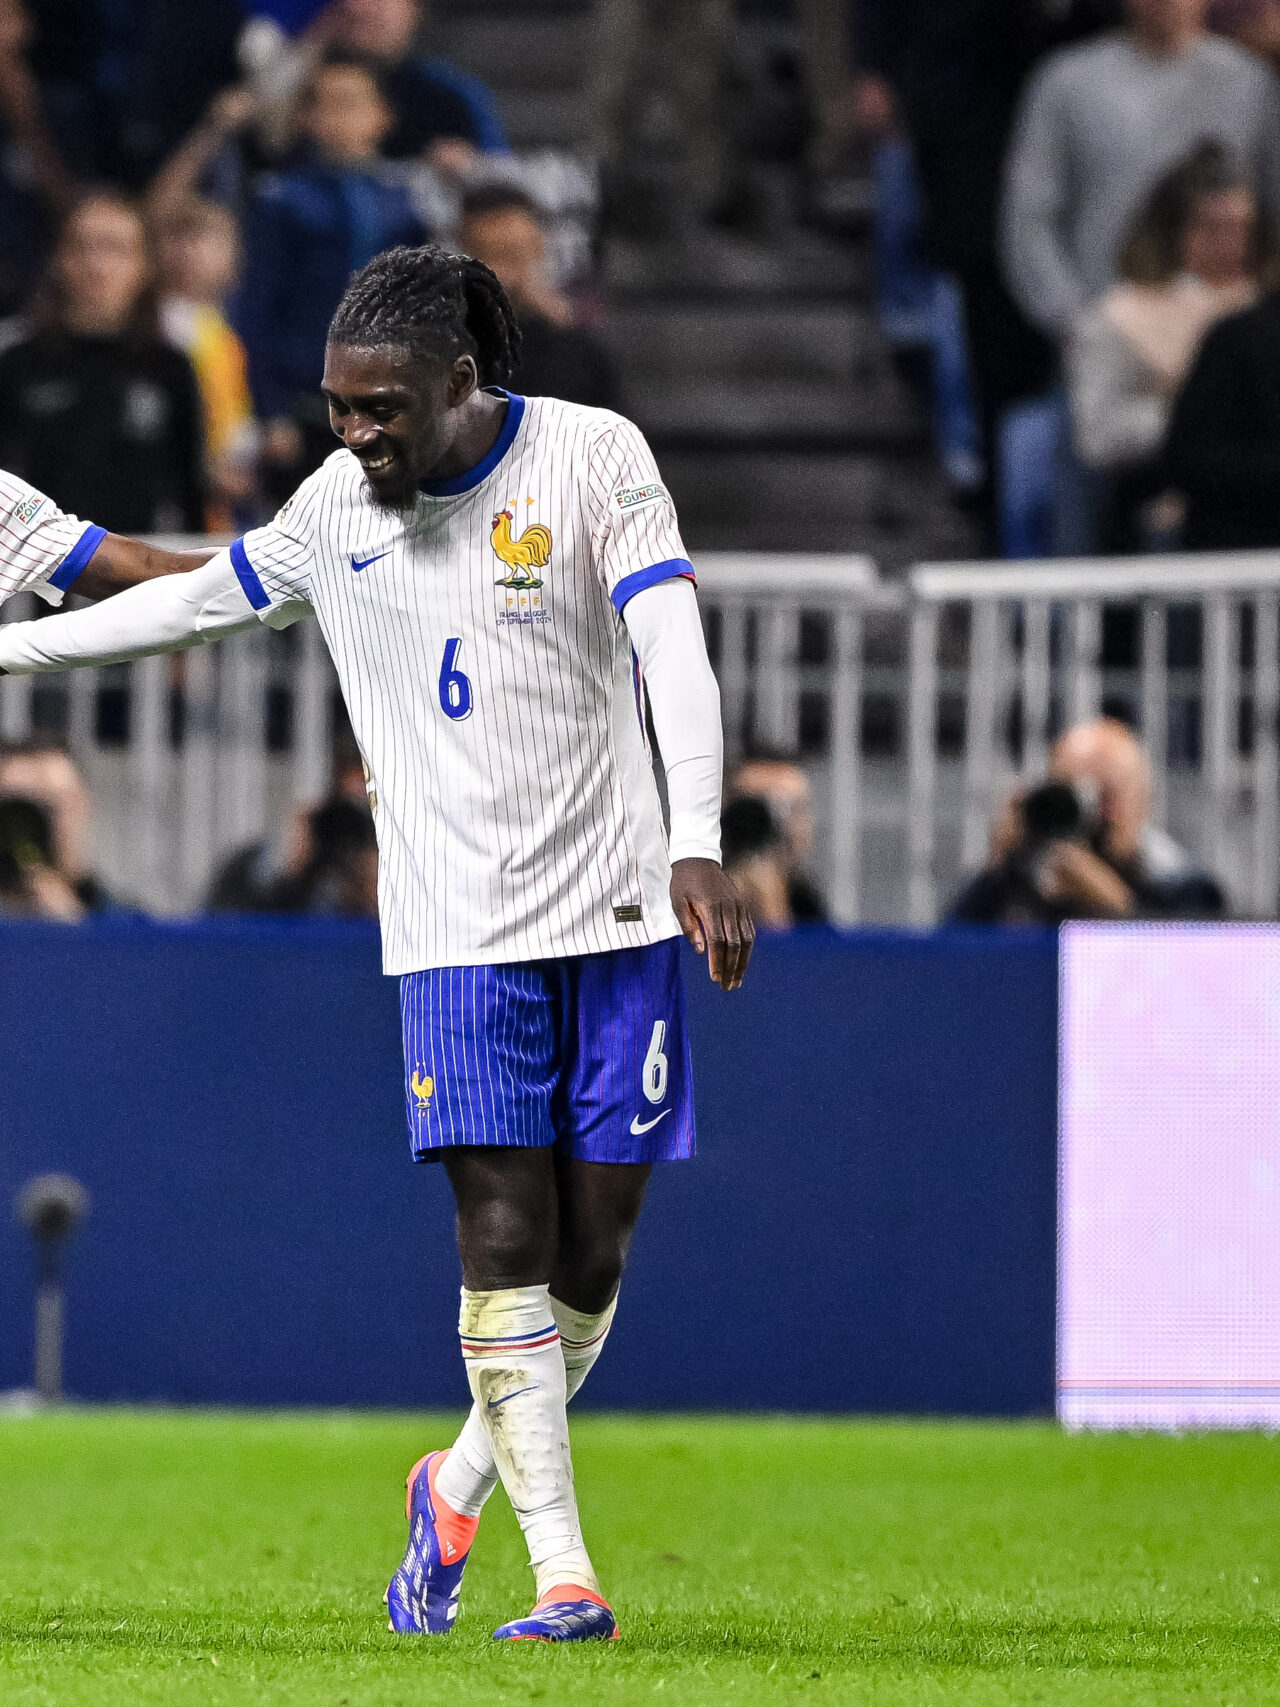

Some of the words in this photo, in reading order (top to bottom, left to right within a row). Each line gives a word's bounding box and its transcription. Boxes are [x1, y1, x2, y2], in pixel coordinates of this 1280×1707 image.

[617, 486, 658, 506] FOUND
[439, 637, 473, 721] 6
[642, 1020, 668, 1104] 6
